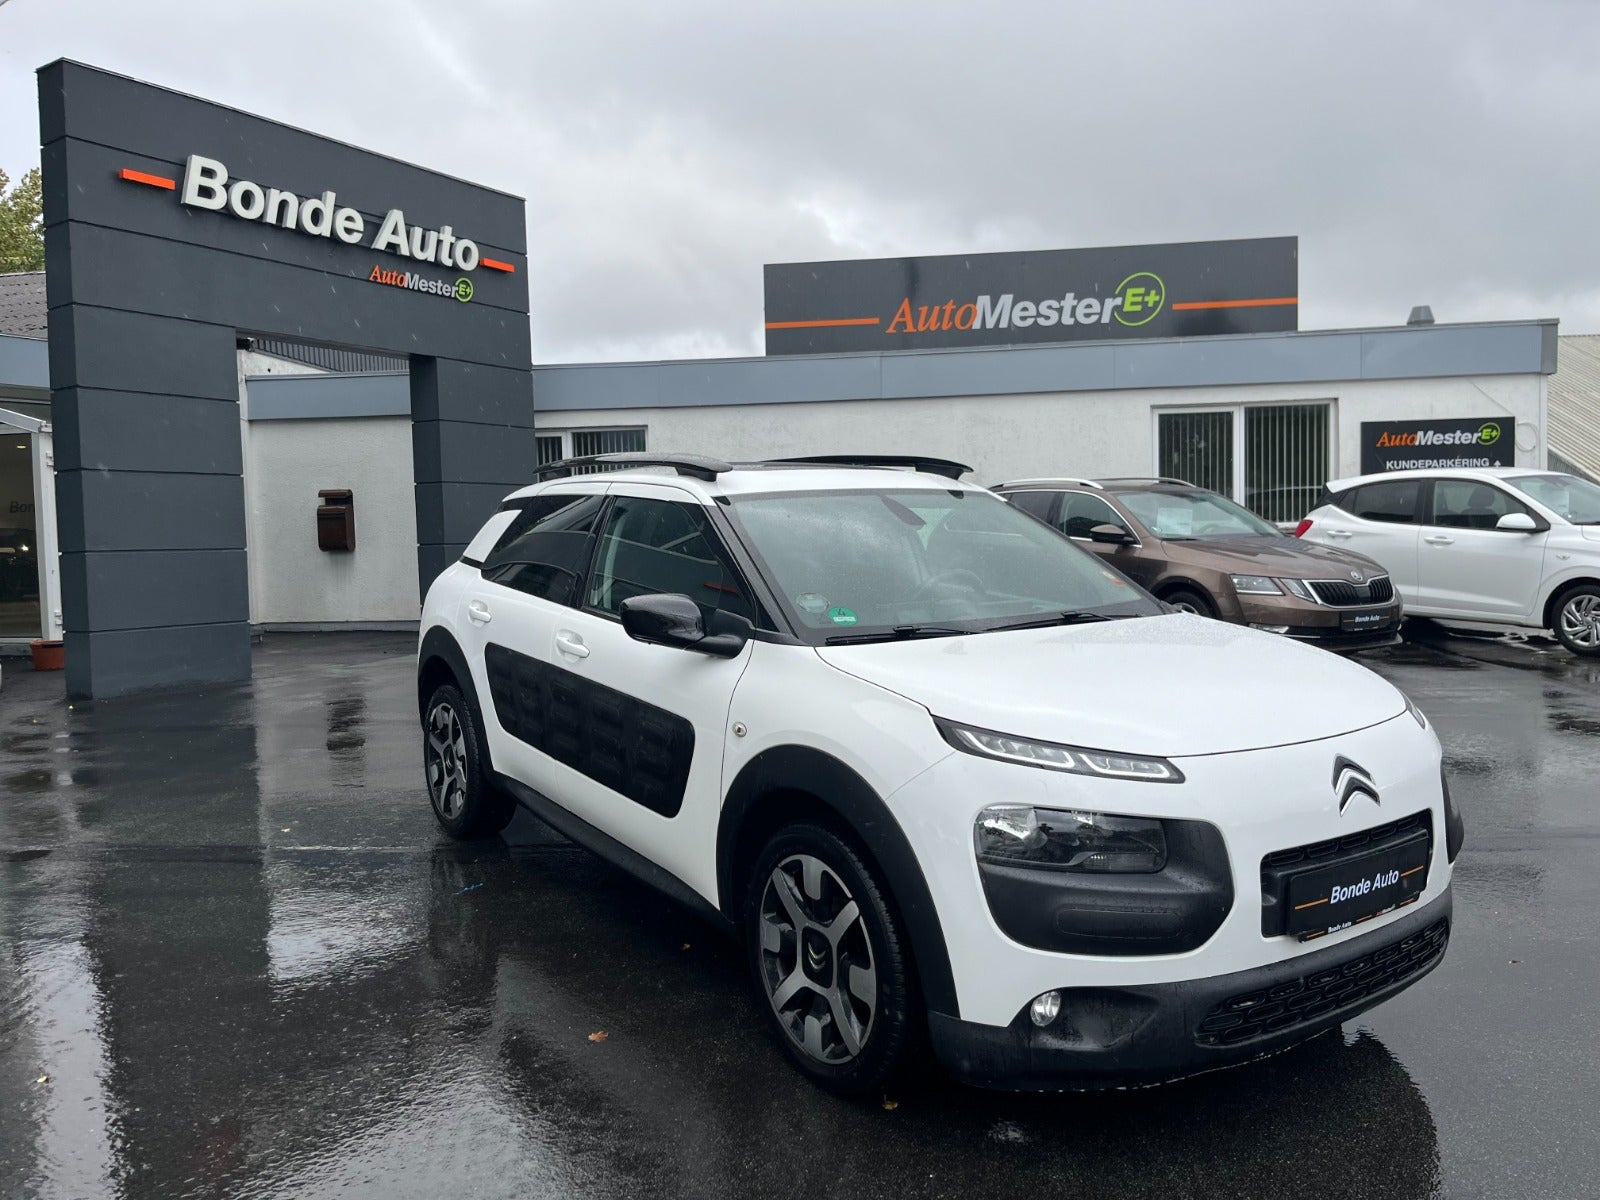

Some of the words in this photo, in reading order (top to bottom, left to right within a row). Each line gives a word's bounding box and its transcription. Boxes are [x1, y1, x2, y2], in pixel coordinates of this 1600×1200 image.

[181, 154, 364, 244] Bonde
[371, 209, 479, 271] Auto
[369, 264, 458, 298] AutoMester
[885, 292, 1121, 333] AutoMester
[1376, 430, 1481, 447] AutoMester
[1330, 878, 1371, 904] Bonde
[1372, 870, 1399, 891] Auto
